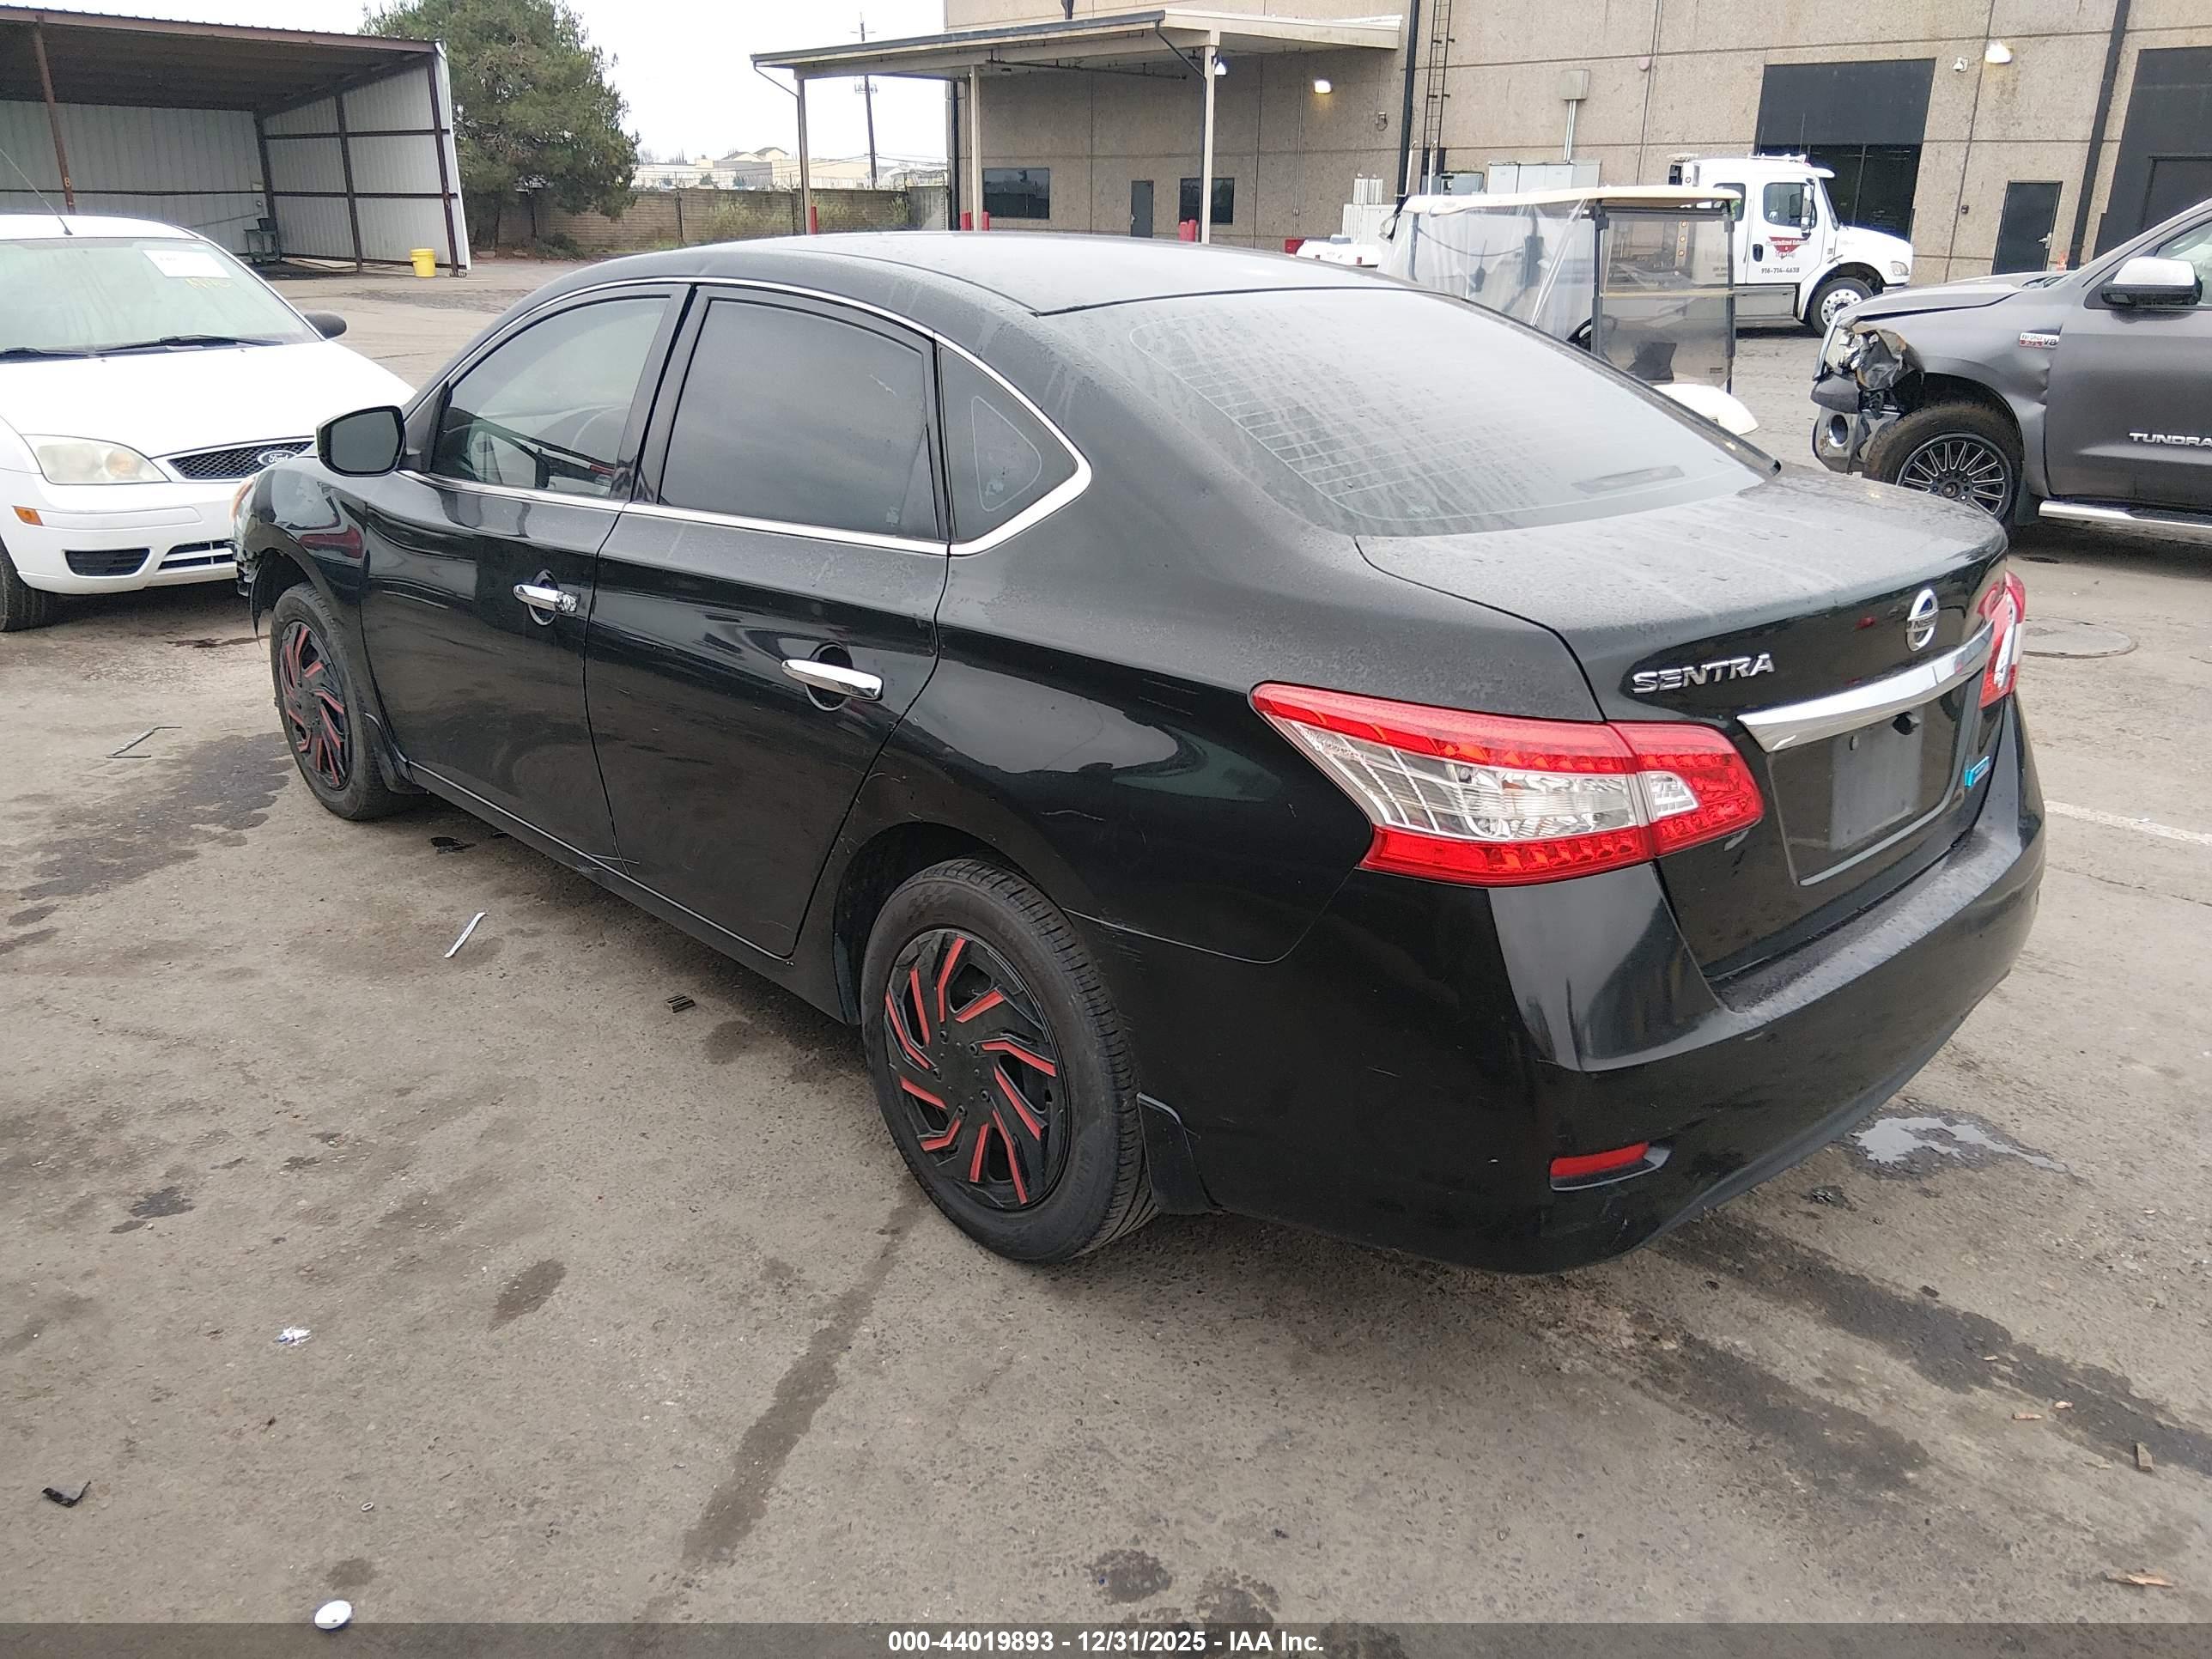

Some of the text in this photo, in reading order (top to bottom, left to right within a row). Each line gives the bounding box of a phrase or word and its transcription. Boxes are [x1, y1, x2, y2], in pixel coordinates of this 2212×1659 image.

[2129, 432, 2212, 447] TUNDRA
[268, 453, 289, 463] Ford
[1631, 653, 1775, 694] SENTRA
